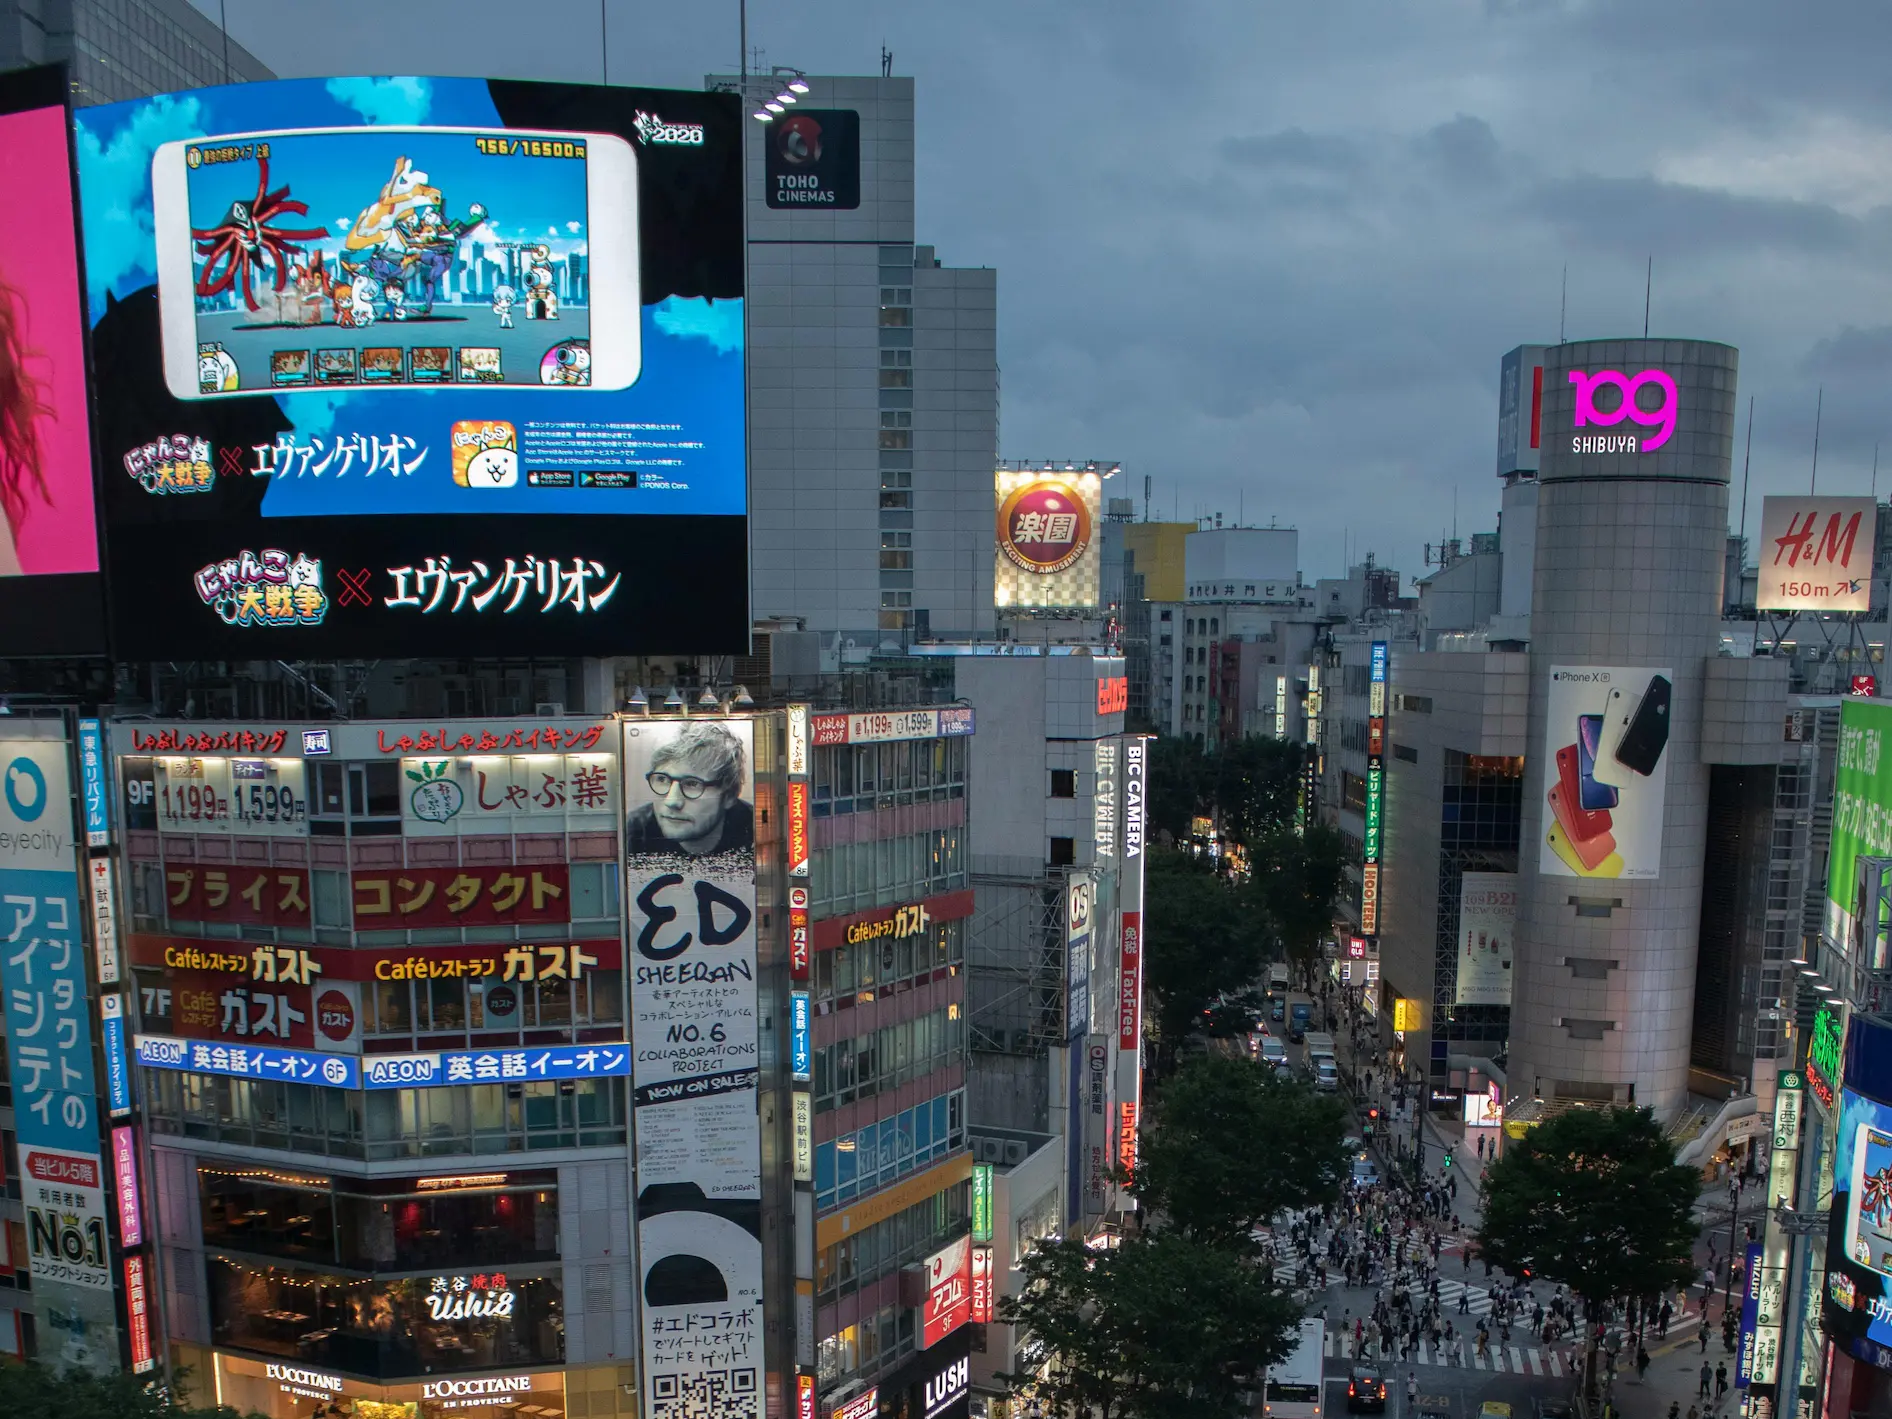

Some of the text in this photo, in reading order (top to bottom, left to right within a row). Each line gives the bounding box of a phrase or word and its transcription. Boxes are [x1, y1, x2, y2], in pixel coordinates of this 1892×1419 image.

[651, 127, 703, 144] 2020
[777, 175, 818, 188] TOHO
[777, 190, 835, 202] CINEMAS
[1568, 369, 1678, 453] 109
[454, 426, 507, 447] にゃんこ
[1572, 436, 1636, 453] SHIBUYA
[250, 433, 429, 480] エヴァンゲリオン
[158, 461, 213, 488] 大戦争
[541, 472, 554, 480] App
[595, 473, 630, 482] Google Play
[1013, 511, 1078, 544] 楽園
[1774, 510, 1862, 568] H&M
[1002, 541, 1087, 574] EXCITING AMUSEMENT
[195, 550, 290, 603] にゃんこ
[384, 554, 621, 613] エヴァンゲリオン
[1224, 584, 1296, 597] 井門ビル
[238, 585, 324, 619] 大戦争
[1374, 646, 1384, 659] THE
[1560, 672, 1590, 683] iPhone
[131, 728, 288, 752] しゃぶしゃぶバイキング
[303, 732, 328, 751] 寿司
[377, 726, 606, 753] しゃぶしゃぶバイキング
[83, 735, 103, 827] 東急リバブル
[128, 779, 153, 804] 9F
[478, 765, 609, 811] しゃぶ葉
[162, 784, 227, 820] 1,199円
[234, 784, 305, 822] 1,599円
[1127, 746, 1141, 858] BIC CAMERA
[1367, 772, 1380, 856] ビリヤード・ダーツ
[0, 829, 63, 856] eyecity
[167, 871, 307, 912] プライス
[355, 872, 562, 914] コンタクト
[1071, 884, 1088, 927] OS
[1363, 869, 1376, 929] HOOTERS
[96, 888, 114, 967] 献血ルーム
[636, 873, 752, 961] ED
[895, 905, 930, 939] ガスト
[793, 928, 807, 971] ガスト
[1124, 926, 1137, 955] 免税
[252, 949, 322, 985] ガスト
[503, 946, 598, 983] ガスト
[636, 958, 752, 985] SHEERAN
[141, 987, 172, 1016] 7F
[652, 987, 739, 1000] 豪華アーティストとの
[668, 998, 724, 1010] スペシャルな
[4, 894, 53, 1126] アイシティ
[45, 896, 87, 1130] コンタクトの
[220, 989, 305, 1039] ガスト
[321, 1011, 351, 1027] ガスト
[639, 1008, 752, 1021] コラボレーション・アルバム
[795, 999, 807, 1072] 英会話イーオン
[141, 1040, 181, 1062] AEON
[193, 1046, 345, 1080] 英会話イーオン 6F
[447, 1050, 626, 1081] 英会話イーオン
[638, 1043, 755, 1062] COLLABORATIONS
[1090, 1046, 1105, 1072] OS
[370, 1059, 432, 1082] AEON
[672, 1059, 724, 1073] PROJECT
[647, 1073, 746, 1101] NOW ON SALE
[796, 1100, 808, 1173] 渋谷駅前ビル
[34, 1157, 94, 1184] 当ビル5階
[974, 1168, 984, 1196] レイク
[39, 1188, 87, 1209] 利用者数
[119, 1148, 136, 1228] 品川美容外科
[27, 1206, 108, 1270] No.1
[125, 1233, 138, 1244] 4F
[32, 1260, 109, 1286] コンタクトショップ
[128, 1257, 144, 1316] 外貨両替
[1750, 1255, 1762, 1300] MIZUHO
[425, 1290, 517, 1321] Ushi8
[932, 1277, 962, 1316] アコム
[974, 1279, 985, 1309] アコム
[652, 1308, 755, 1334] #エドコラボ
[942, 1314, 953, 1332] 3F
[653, 1332, 756, 1350] でツイートしてギフト
[266, 1363, 343, 1392] L'OCCITANE
[423, 1376, 531, 1400] L'OCCITANE
[926, 1356, 968, 1410] LUSH
[292, 1386, 330, 1400] PROVENCE
[443, 1396, 512, 1408] EN PROVENCE
